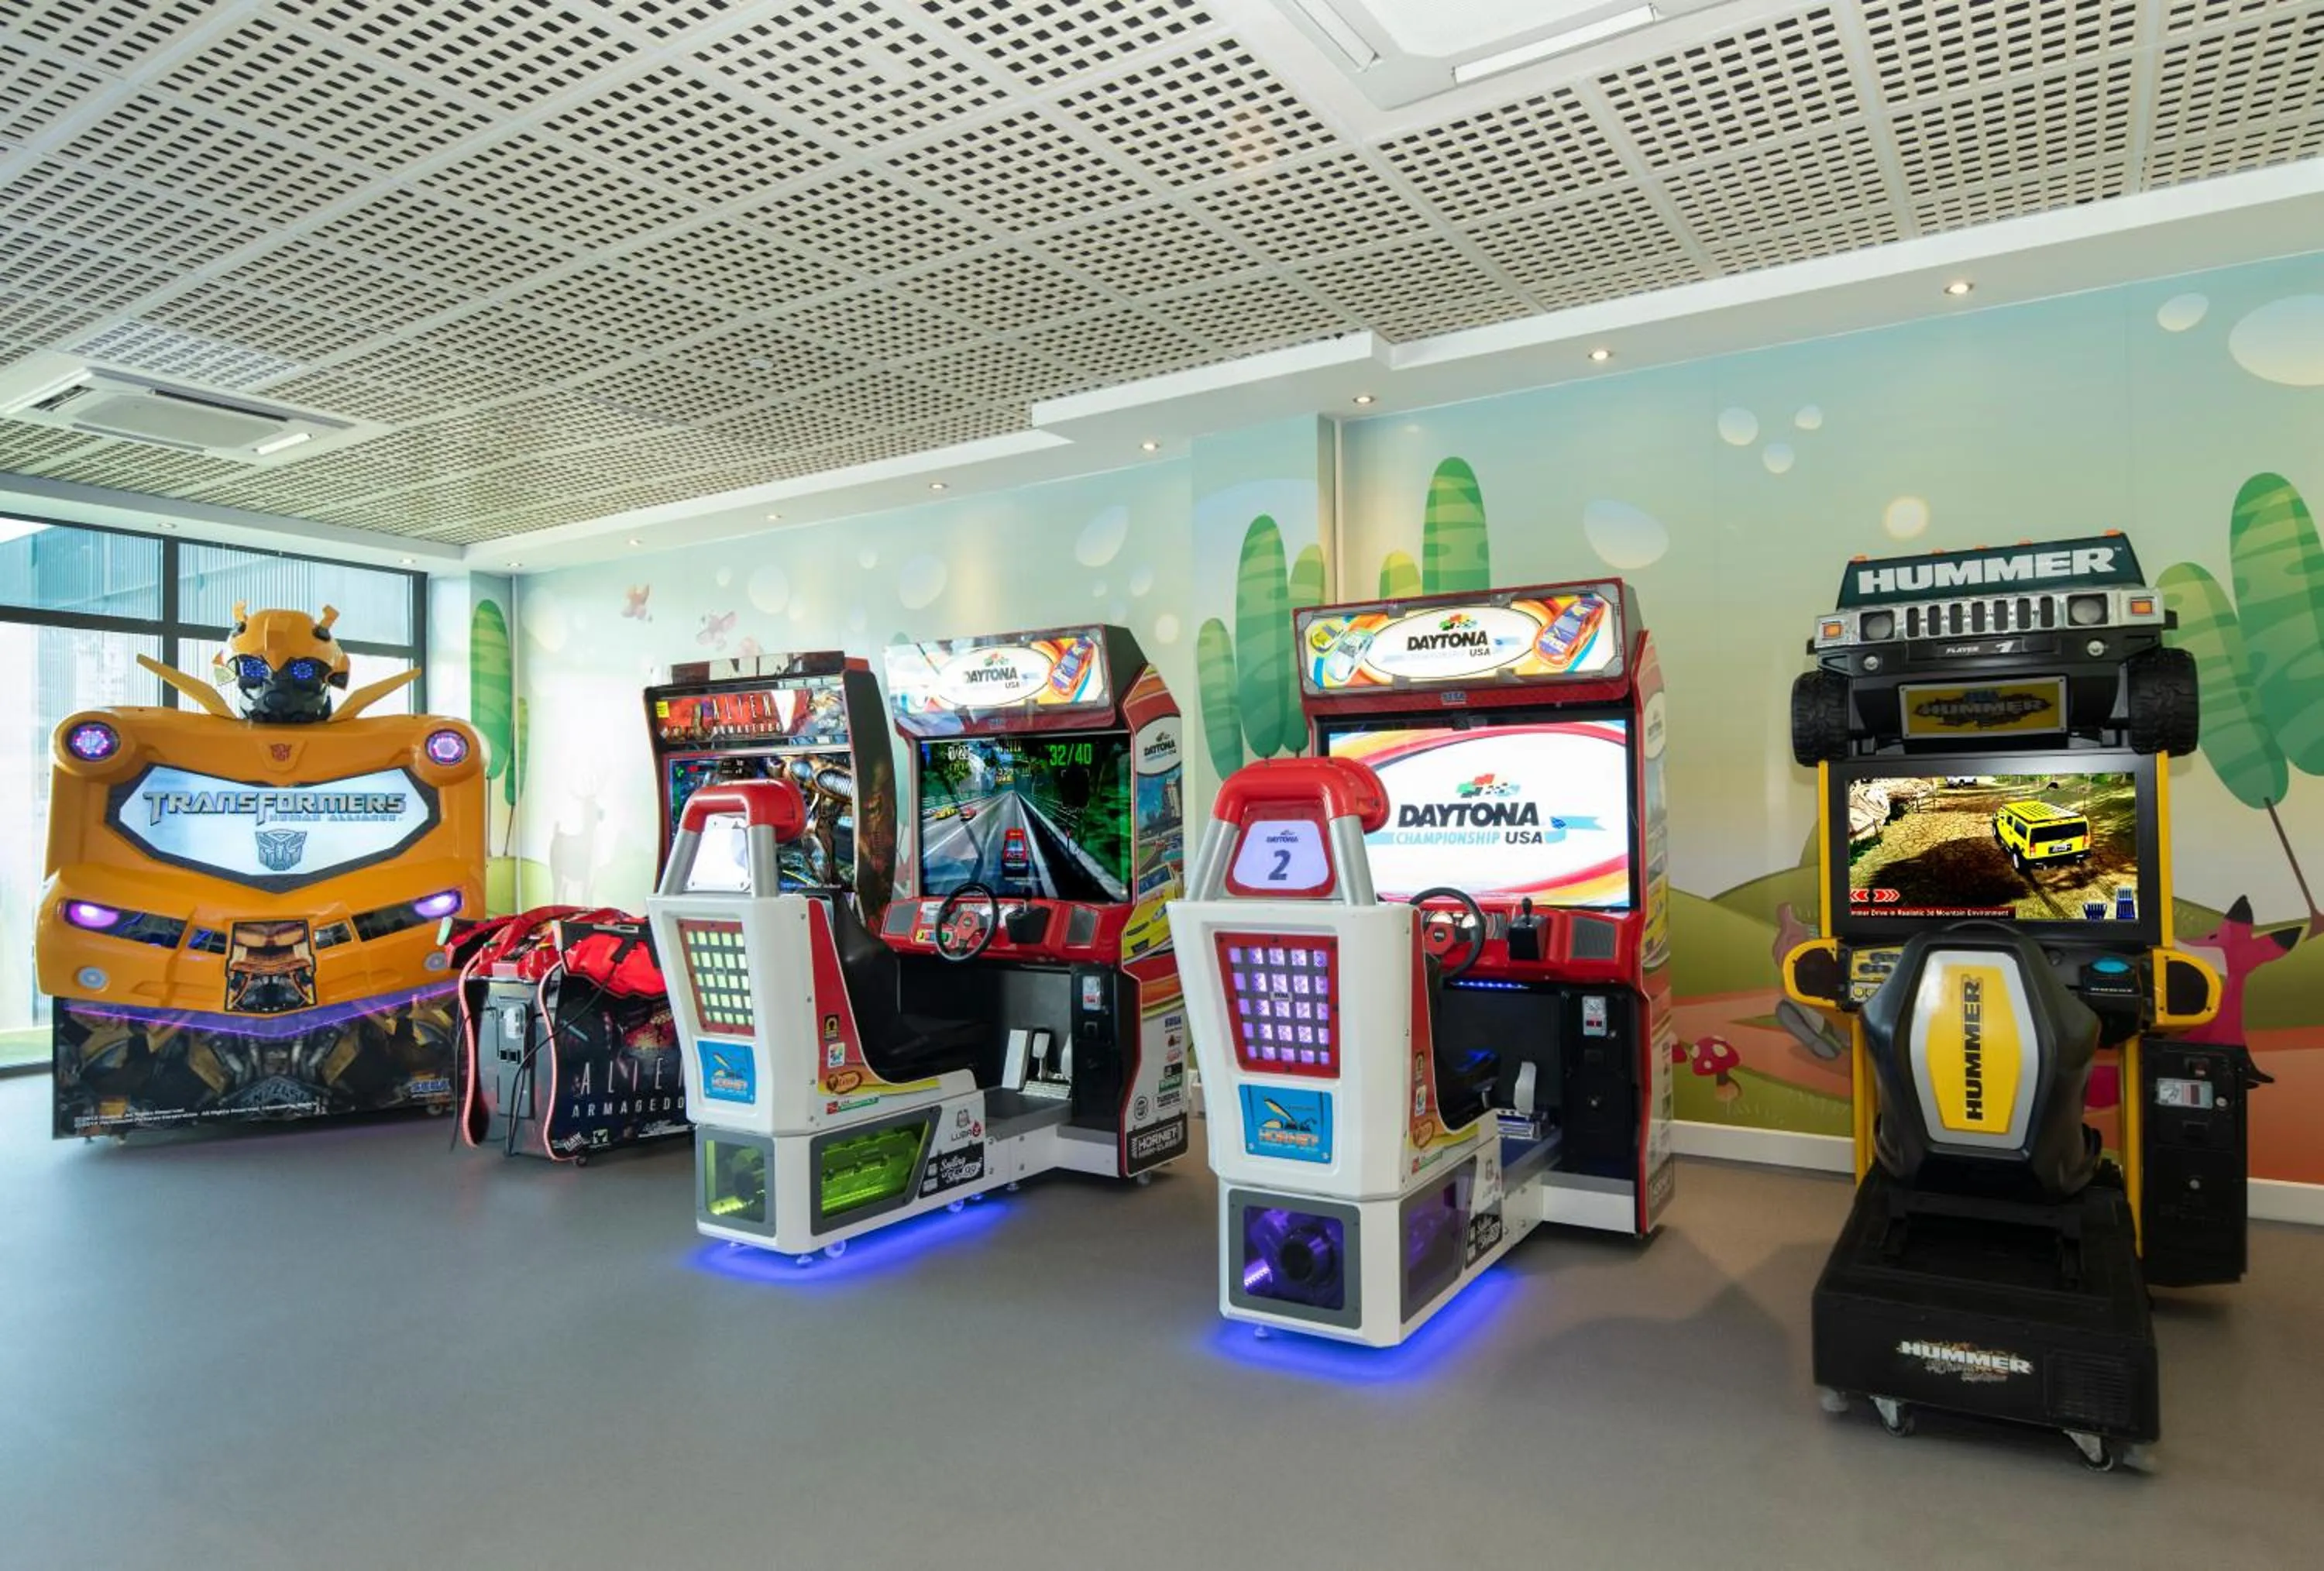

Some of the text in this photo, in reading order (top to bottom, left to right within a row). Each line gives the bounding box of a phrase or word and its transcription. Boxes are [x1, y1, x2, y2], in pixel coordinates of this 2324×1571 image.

[1858, 547, 2116, 594] HUMMER
[1407, 631, 1488, 651] DAYTONA
[1470, 648, 1490, 658] USA
[712, 694, 772, 720] ALIEN
[1049, 743, 1092, 766] 32/40
[143, 791, 407, 827] TRANSFORMERS
[1397, 802, 1539, 828] DAYTONA
[1395, 831, 1542, 844] CHAMPIONSHIP USA
[1267, 849, 1291, 880] 2
[1964, 981, 1983, 1120] HUMMER
[581, 1058, 685, 1095] ALIE
[1138, 1127, 1177, 1152] HORNET
[1899, 1340, 2033, 1375] HUMMER
